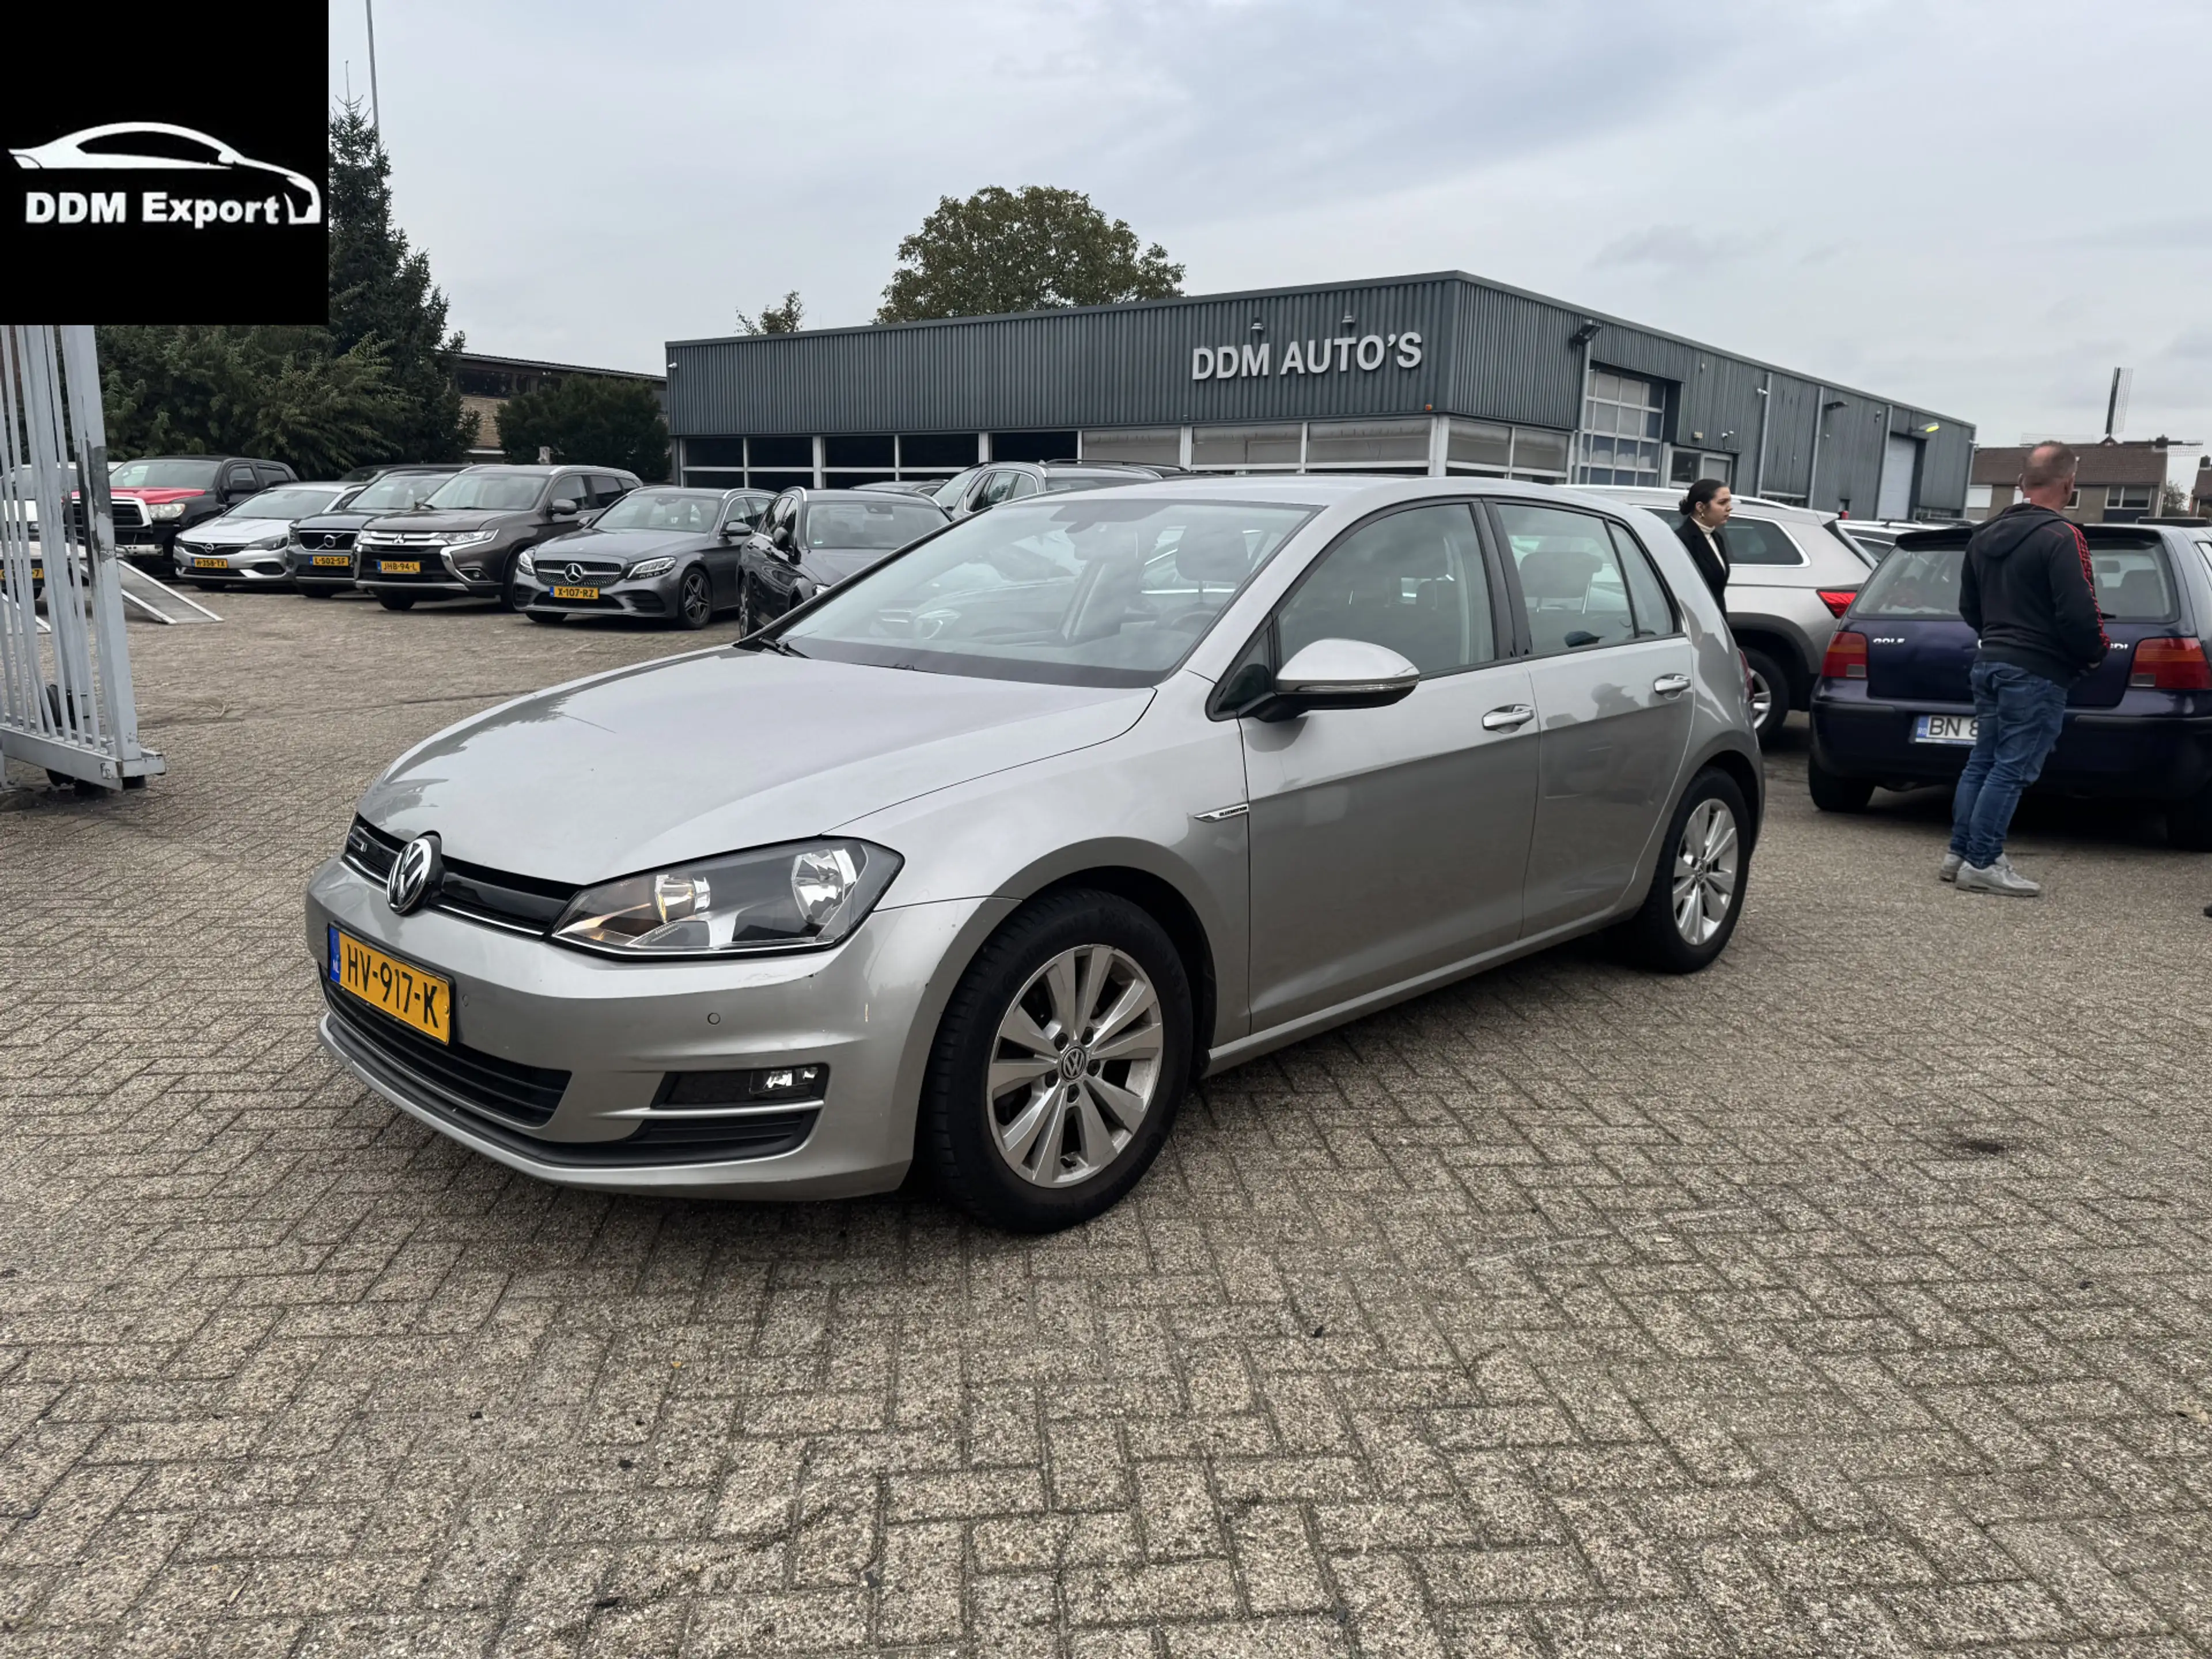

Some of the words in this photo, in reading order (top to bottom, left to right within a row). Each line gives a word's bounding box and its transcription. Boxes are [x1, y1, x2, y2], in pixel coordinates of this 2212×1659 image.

[1192, 343, 1270, 380] DDM
[1279, 331, 1423, 375] AUTO'S
[557, 588, 594, 597] X-107-RZ
[1929, 717, 1961, 737] BN
[347, 944, 439, 1029] HV-917-K
